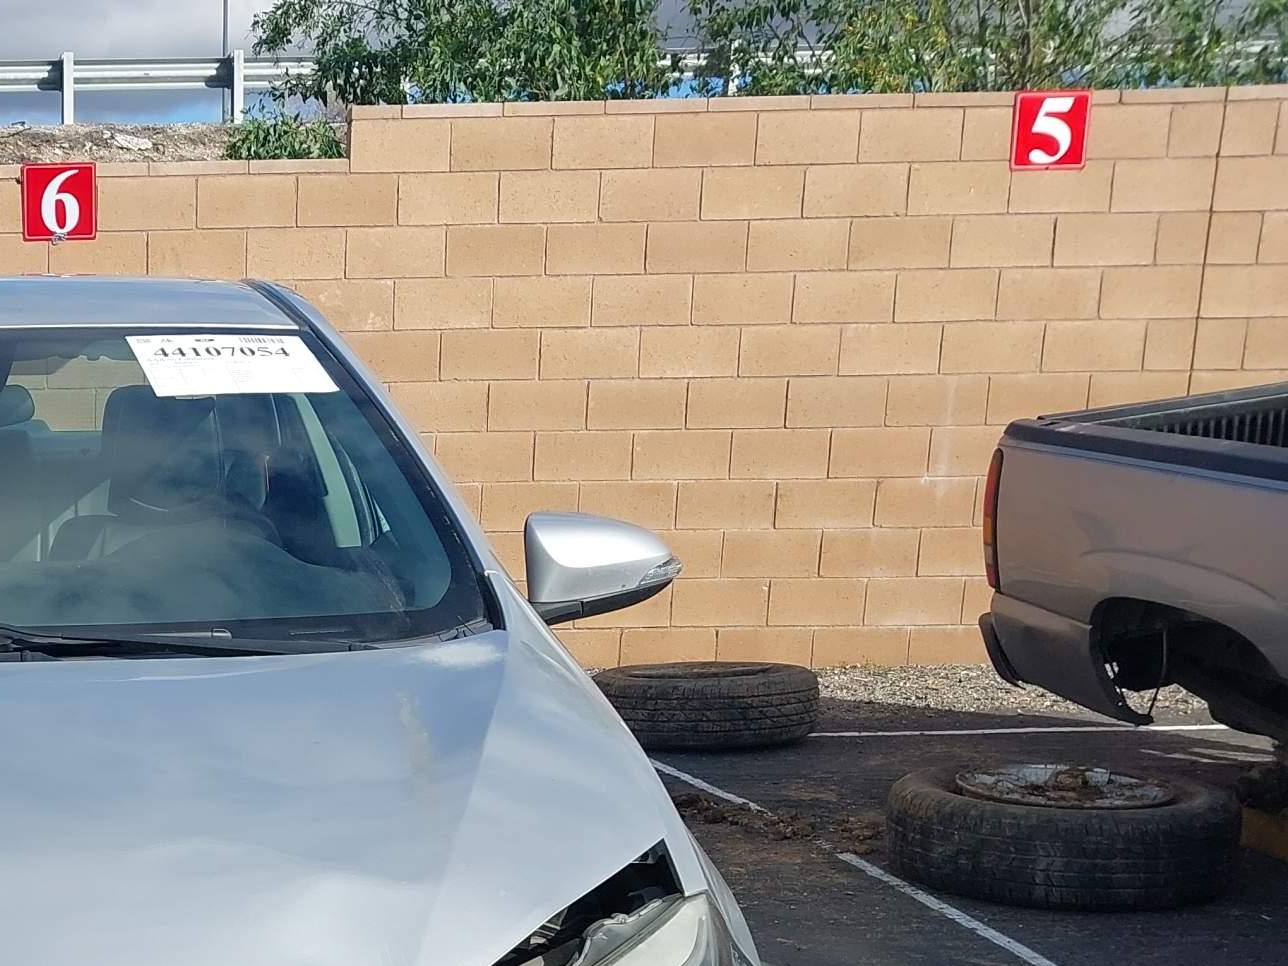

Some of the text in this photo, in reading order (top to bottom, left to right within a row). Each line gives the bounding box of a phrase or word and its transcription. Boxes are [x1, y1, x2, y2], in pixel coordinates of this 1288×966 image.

[1028, 96, 1076, 164] 5
[41, 169, 80, 234] 6
[153, 346, 291, 358] 44107054
